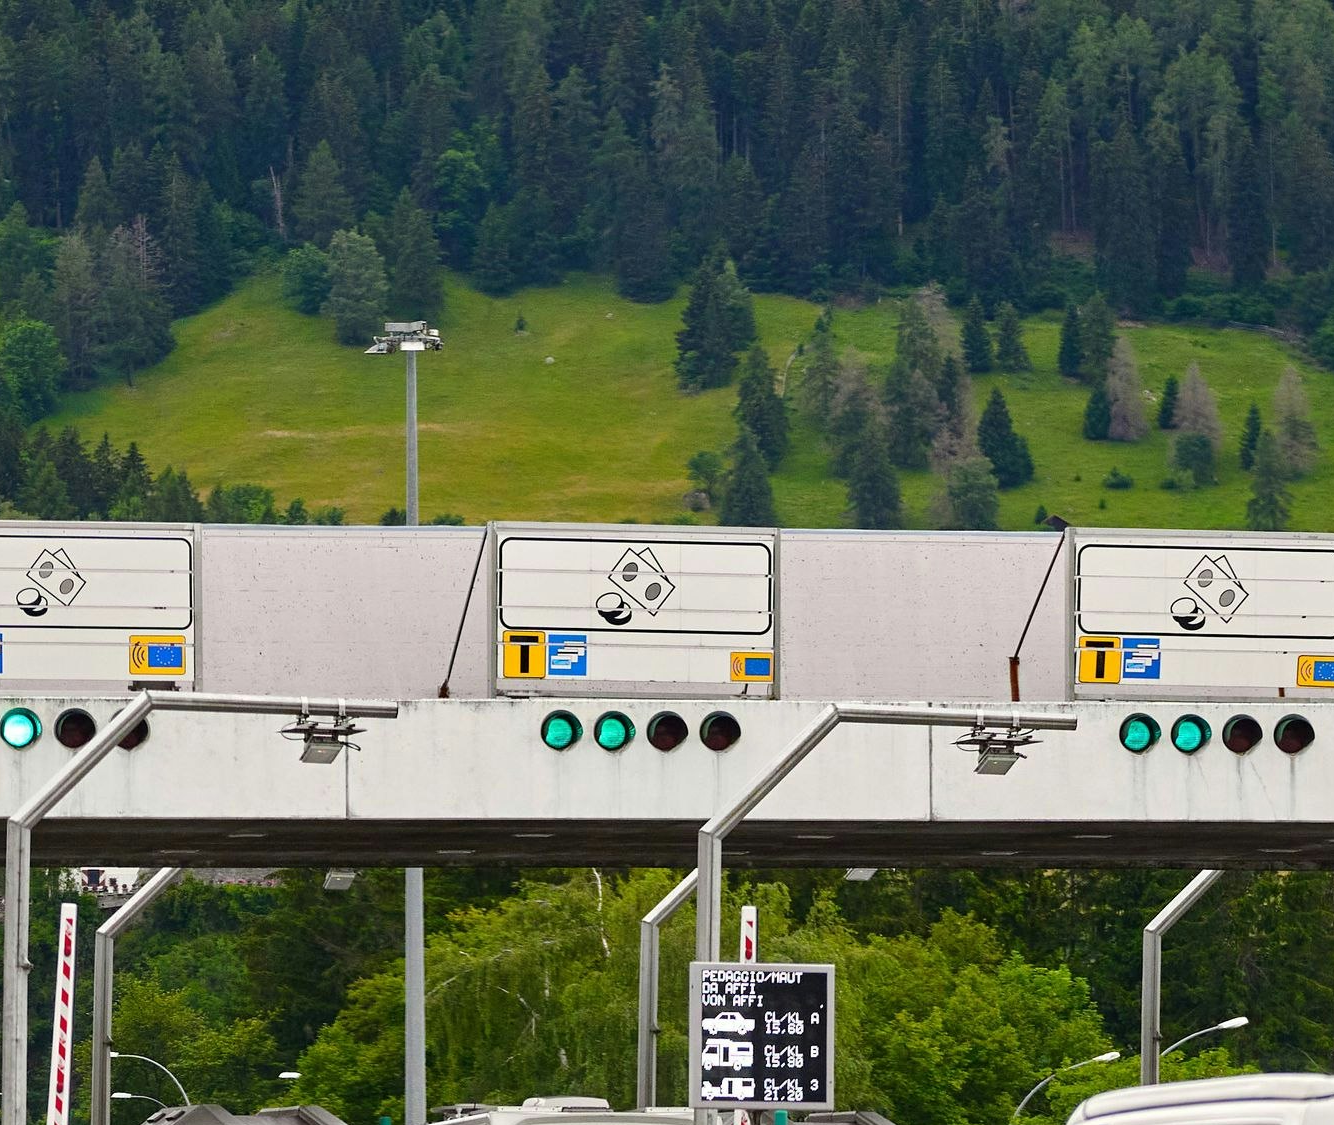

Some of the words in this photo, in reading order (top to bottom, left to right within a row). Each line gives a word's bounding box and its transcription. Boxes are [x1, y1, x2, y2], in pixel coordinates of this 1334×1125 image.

[510, 636, 538, 673] T
[1086, 641, 1114, 678] T
[702, 970, 803, 984] PEDAGGIO/MAUT
[702, 982, 718, 994] DA
[725, 982, 756, 994] AFFI
[702, 994, 726, 1006] VON
[733, 995, 763, 1007] AFFI
[765, 1011, 804, 1023] CL/KL
[811, 1012, 819, 1024] A
[764, 1045, 803, 1057] CL/KL
[811, 1046, 819, 1057] B
[764, 1078, 803, 1090] CL/KL
[810, 1079, 819, 1091] 3
[764, 1089, 803, 1101] 21,20
